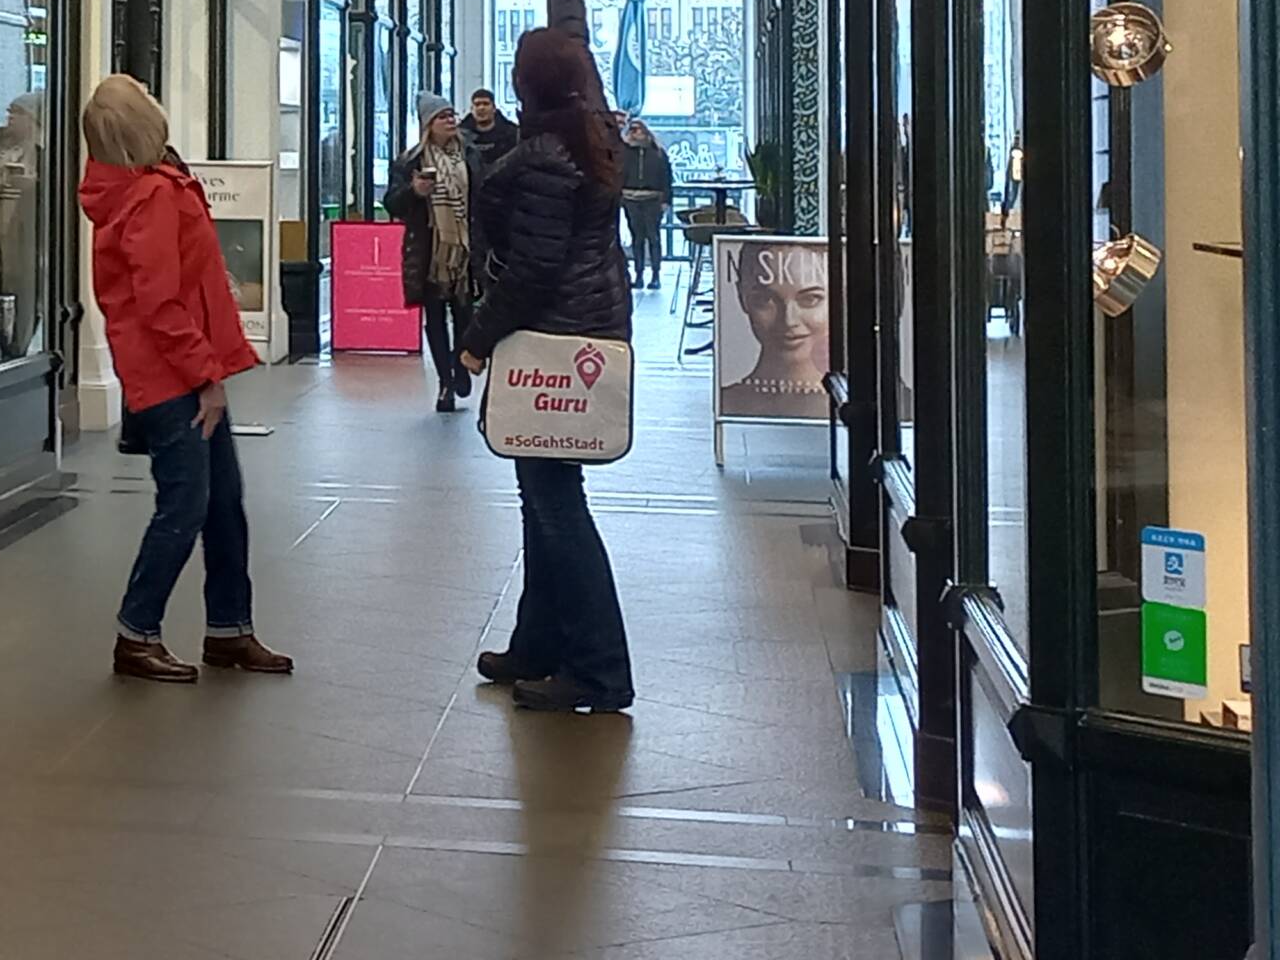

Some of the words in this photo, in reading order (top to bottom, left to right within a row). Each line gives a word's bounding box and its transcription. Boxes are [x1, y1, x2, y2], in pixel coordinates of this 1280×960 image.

[757, 250, 828, 286] SKIN
[507, 368, 572, 390] Urban
[534, 393, 589, 414] Guru
[504, 435, 605, 451] #SoGehtStadt
